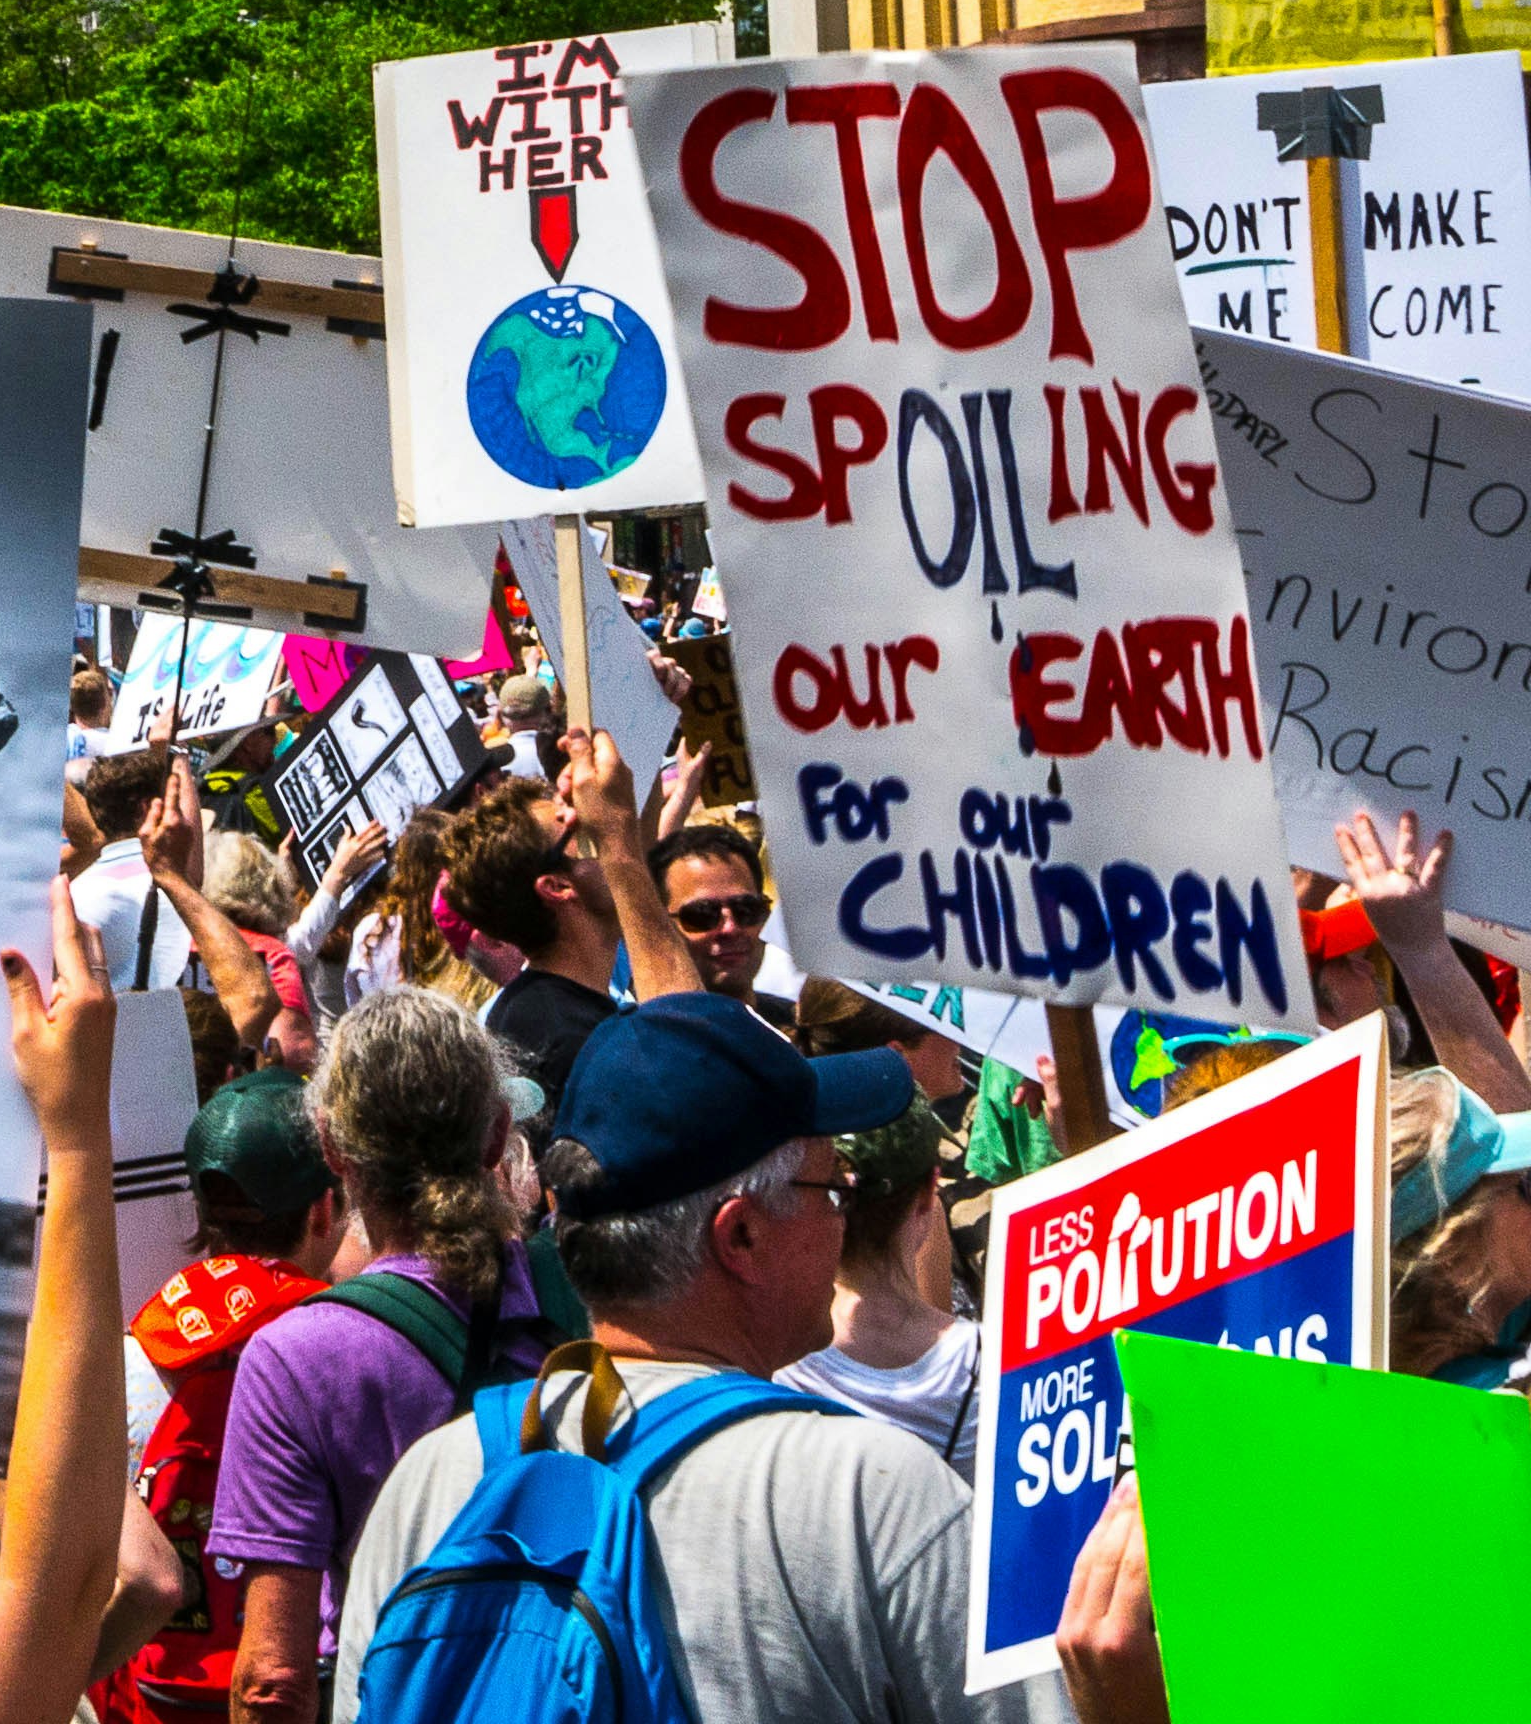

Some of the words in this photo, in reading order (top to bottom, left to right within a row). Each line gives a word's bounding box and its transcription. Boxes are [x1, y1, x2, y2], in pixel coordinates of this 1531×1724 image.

[494, 36, 621, 93] I'M
[447, 82, 633, 149] WITH
[479, 136, 608, 193] HER
[678, 68, 1152, 367] STOP
[1164, 197, 1300, 261] DON'T
[1364, 189, 1497, 251] MAKE
[1219, 288, 1291, 342] ME
[1369, 285, 1503, 339] COME
[723, 380, 1217, 599] SPOILING
[1295, 388, 1531, 593] Sto
[178, 683, 227, 731] Life
[1011, 613, 1264, 762] EARTH
[838, 847, 1290, 1017] CHILDREN
[1029, 1204, 1094, 1266] LESS
[1020, 1358, 1095, 1423] MORE
